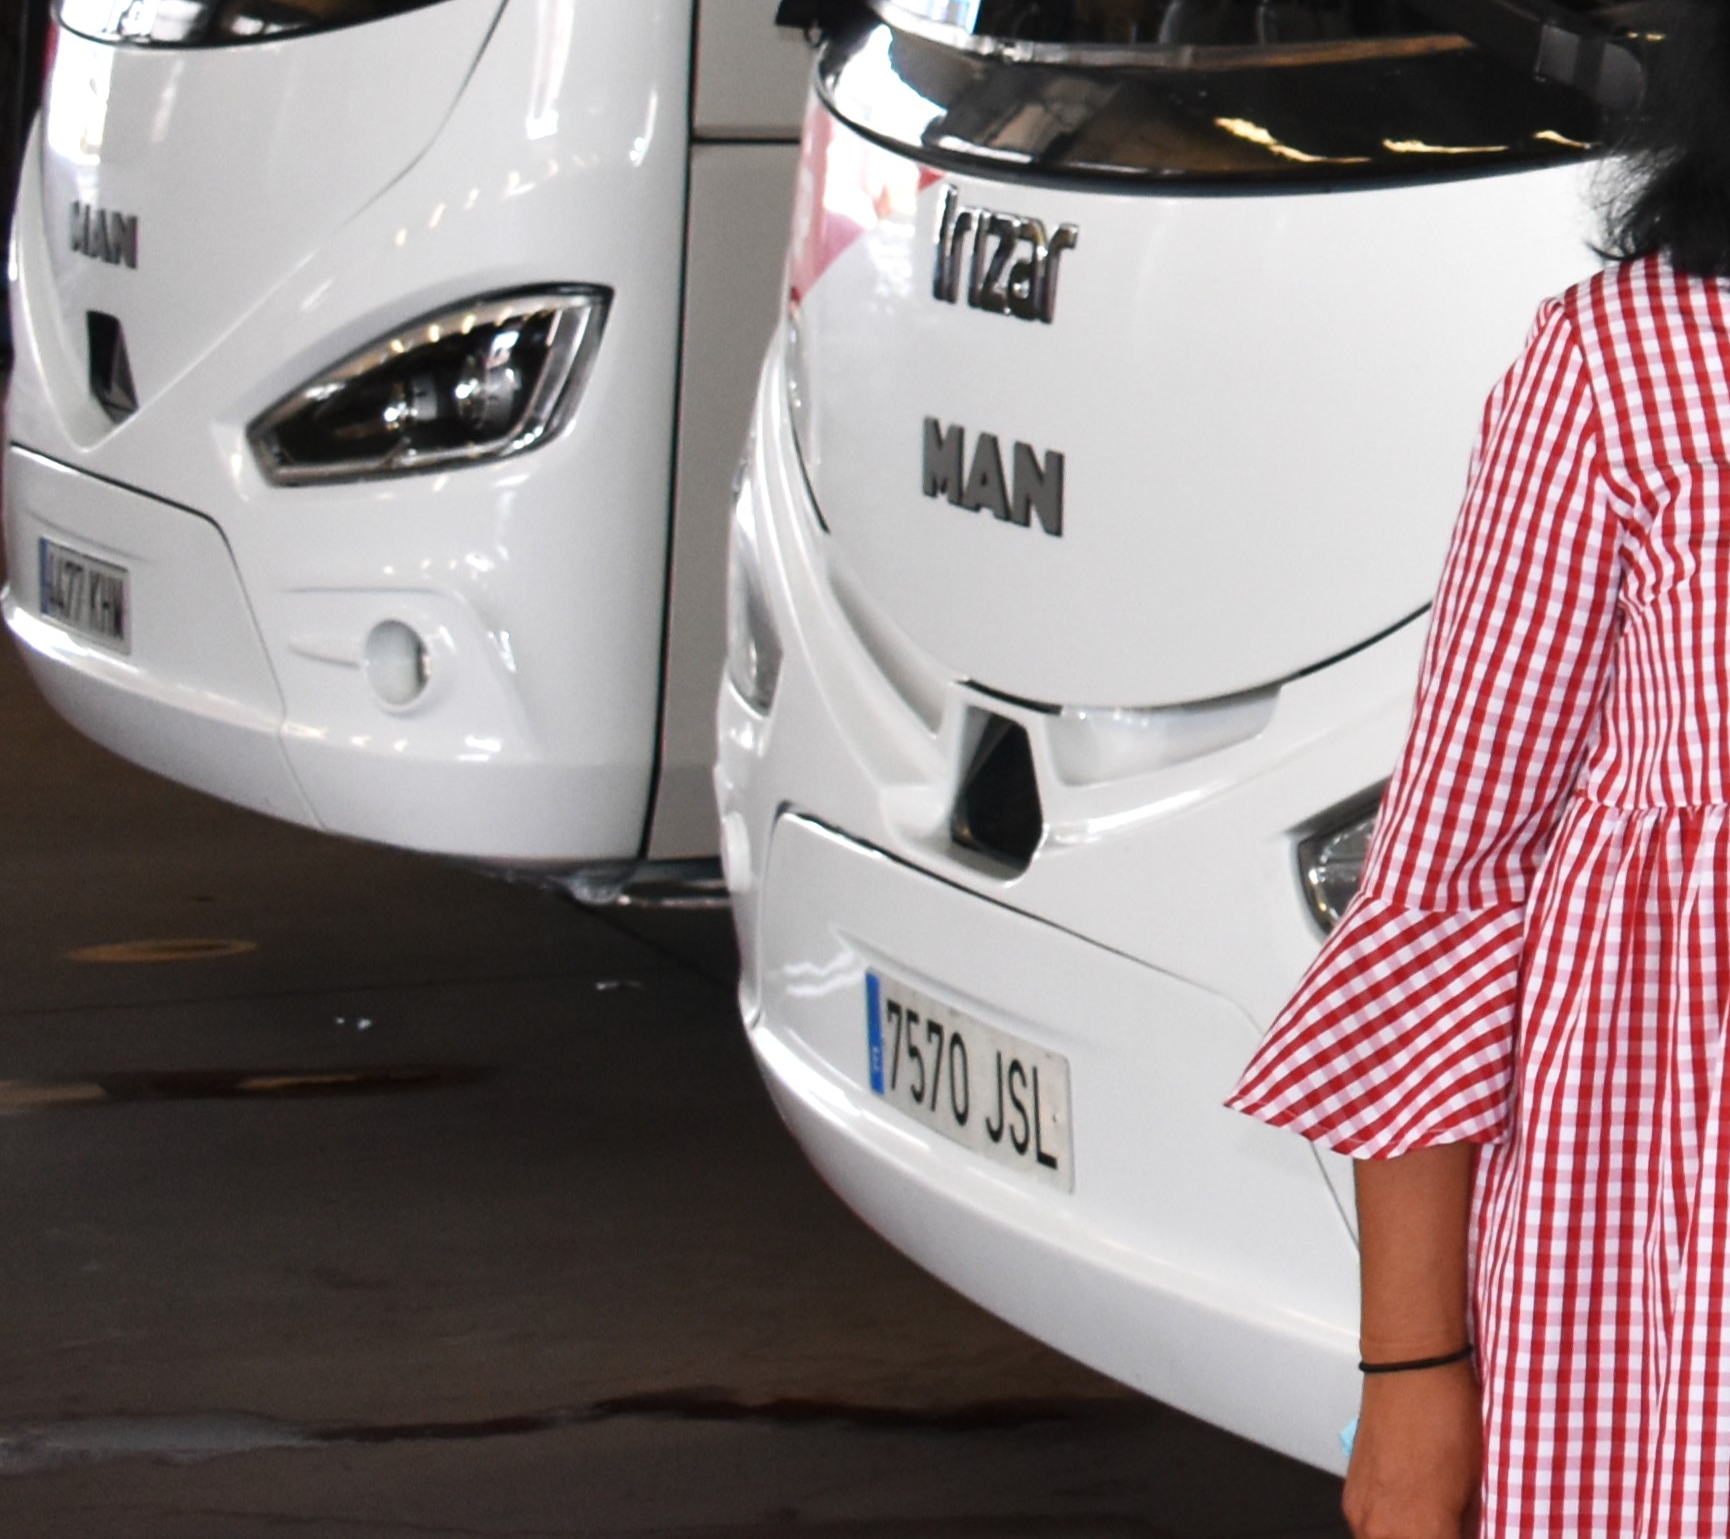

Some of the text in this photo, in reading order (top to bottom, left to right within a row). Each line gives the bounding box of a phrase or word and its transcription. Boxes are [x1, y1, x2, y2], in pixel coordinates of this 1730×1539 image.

[69, 200, 138, 270] MAN
[932, 183, 1080, 325] Irizar
[922, 415, 1064, 538] MAN
[886, 998, 1058, 1171] 7570 JSL
